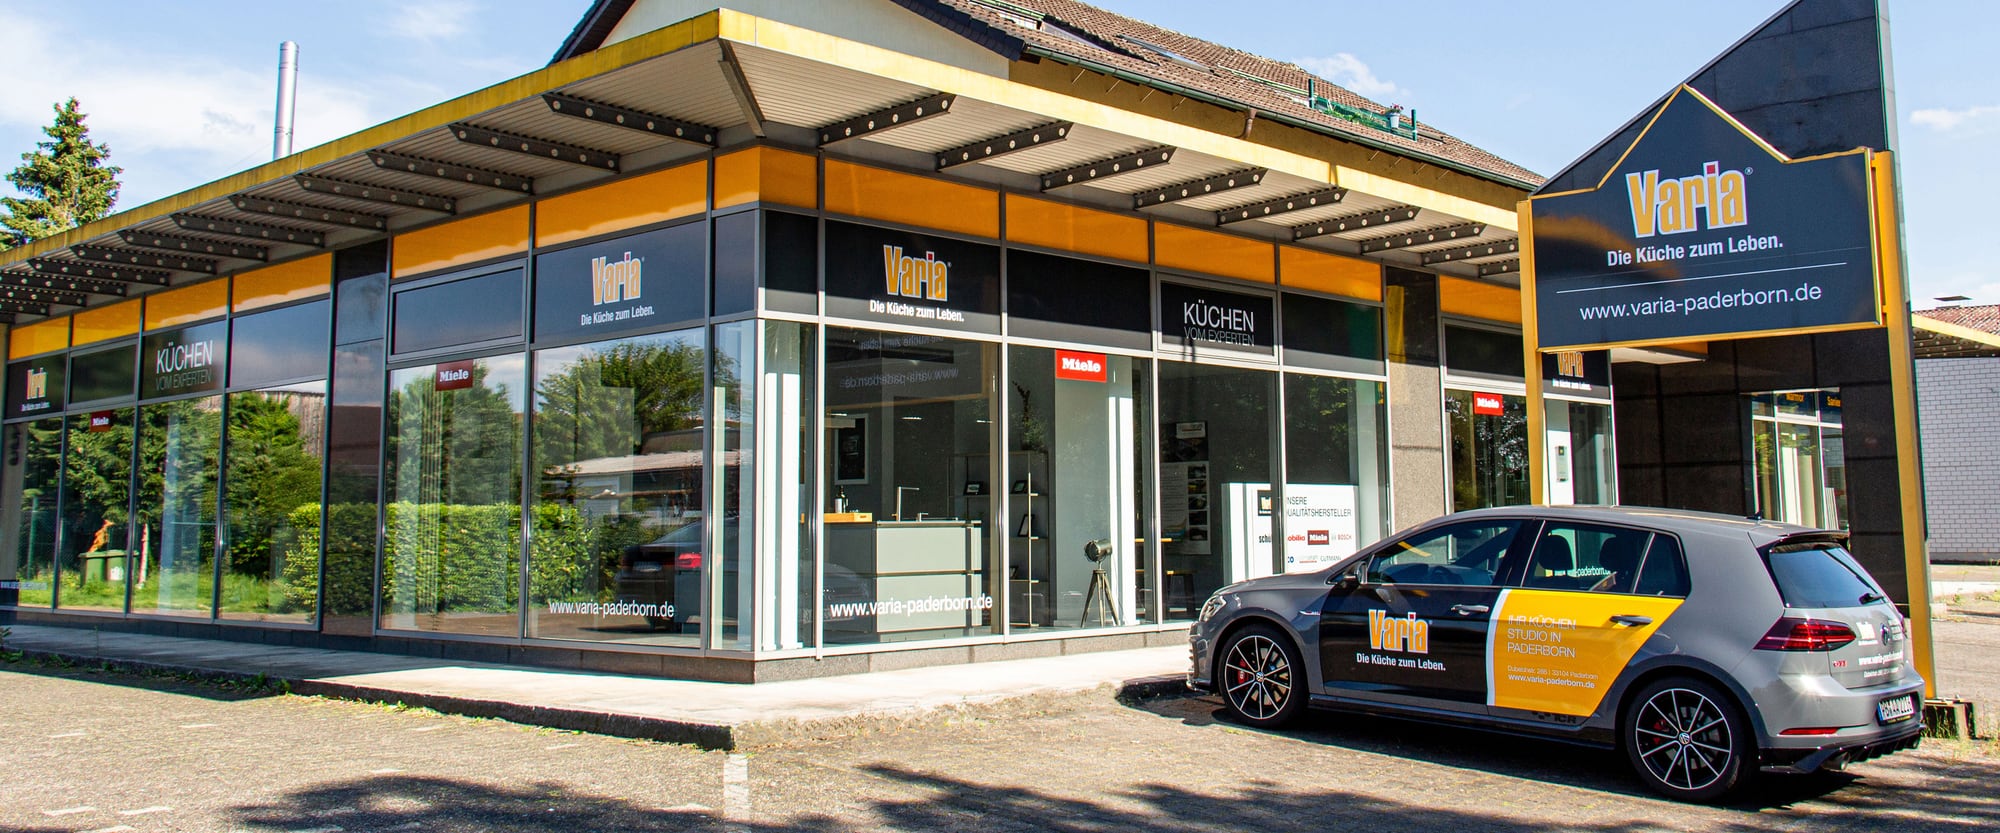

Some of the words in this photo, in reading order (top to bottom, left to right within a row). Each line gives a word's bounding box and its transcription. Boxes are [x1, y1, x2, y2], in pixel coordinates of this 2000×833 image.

[1625, 161, 1748, 238] Varia
[1607, 250, 1632, 267] Die
[1636, 244, 1685, 264] Küche
[1689, 241, 1723, 258] zum
[1728, 235, 1783, 253] Leben.
[591, 251, 642, 306] Varia
[883, 244, 948, 302] Varia
[869, 299, 885, 313] Die
[887, 301, 915, 317] Küche
[916, 306, 935, 319] zum
[936, 307, 965, 322] Leben.
[1579, 282, 1822, 320] www.varia-paderborn.de
[581, 313, 592, 326] Die
[593, 310, 614, 324] Küche
[615, 309, 630, 321] zum
[631, 305, 655, 319] Leben.
[1183, 298, 1255, 333] KÜCHEN
[1183, 326, 1207, 341] VOM
[1208, 329, 1255, 347] EXPERTEN
[156, 340, 214, 375] KÜCHEN
[1061, 357, 1101, 373] Miele
[156, 374, 173, 391] VOM
[173, 368, 213, 389] EXPERTEN
[439, 368, 470, 382] Miele
[1286, 497, 1308, 505] NSERE
[548, 599, 675, 619] www.varia-paderborn.de
[830, 592, 993, 616] www.varia-paderborn.de
[1368, 608, 1429, 654] Varia
[1508, 615, 1526, 626] IHR
[1529, 613, 1577, 630] KÜCHEN
[1507, 628, 1548, 642] STUDIO
[1551, 631, 1562, 643] IN
[1507, 641, 1576, 658] PADERBORN
[1356, 652, 1370, 663] Die
[1371, 653, 1396, 666] Küche
[1398, 659, 1416, 668] zum
[1418, 658, 1446, 671] Leben.
[1508, 674, 1595, 689] www.varia-paderborn.de
